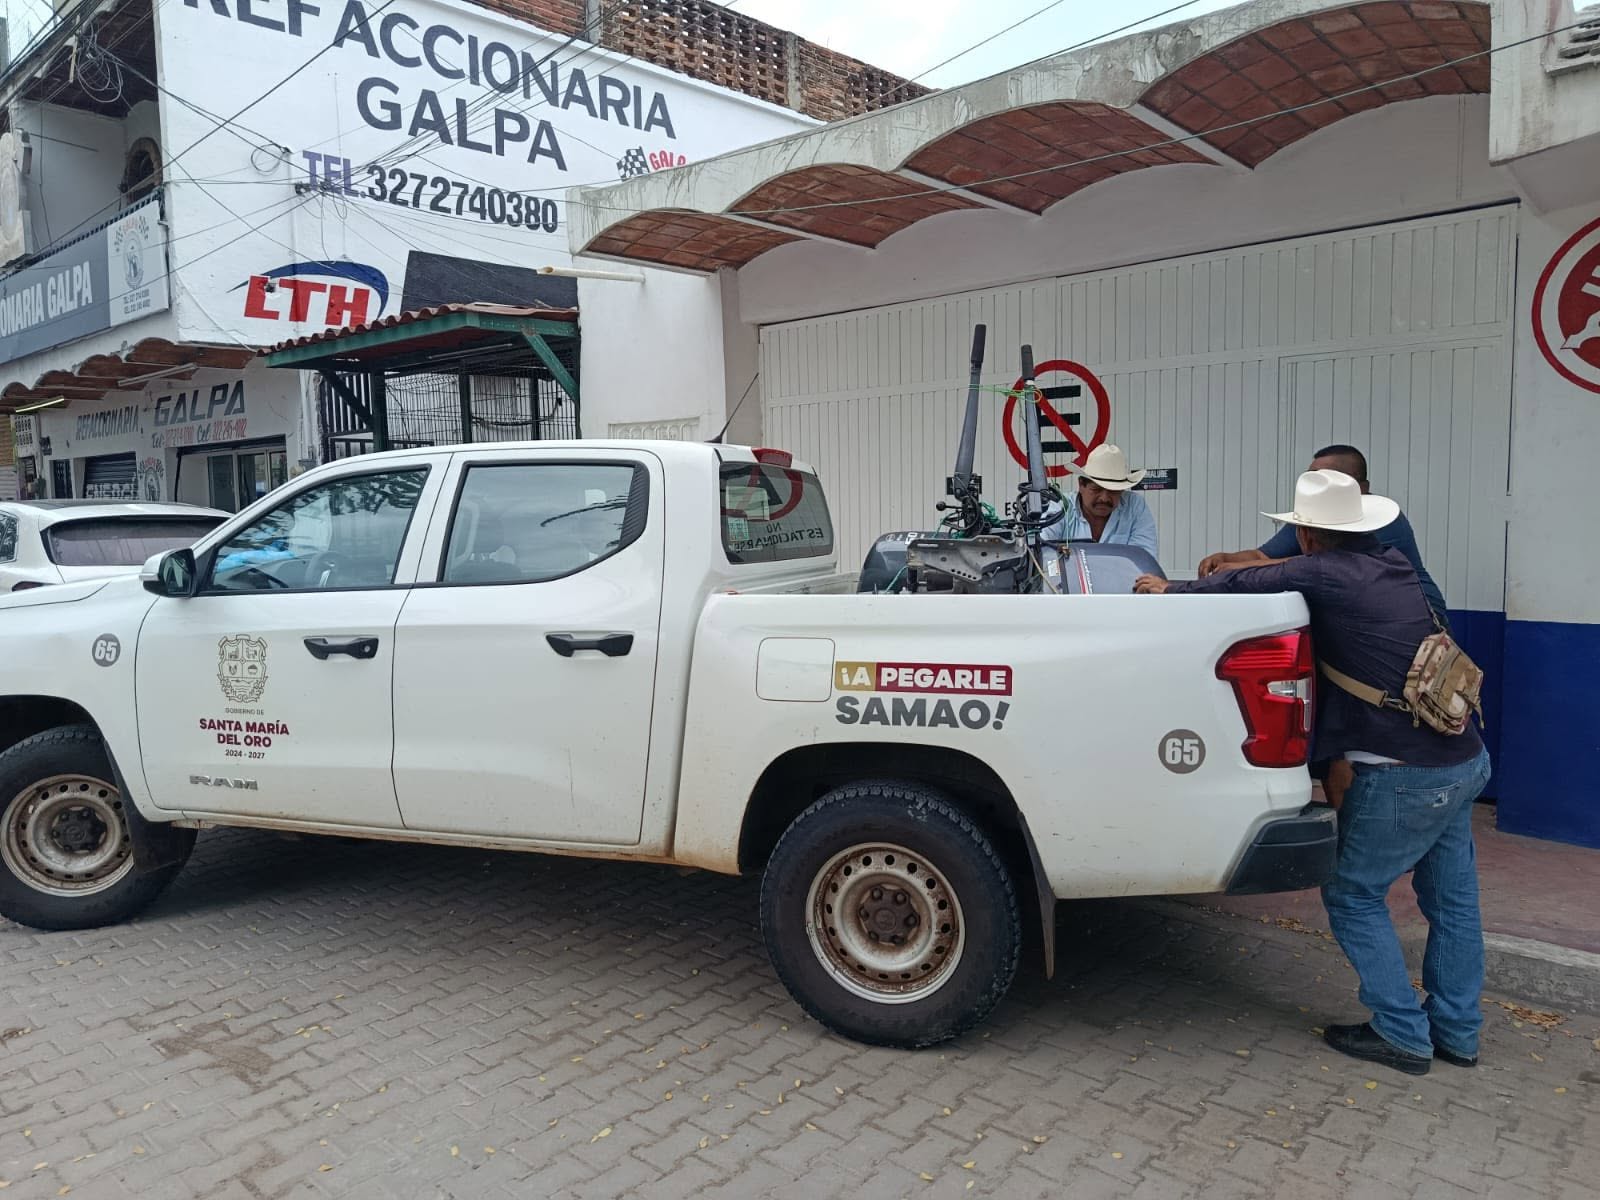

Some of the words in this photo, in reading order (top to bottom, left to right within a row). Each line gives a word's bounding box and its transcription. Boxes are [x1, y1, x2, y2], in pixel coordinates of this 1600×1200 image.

[184, 0, 676, 140] FACCIONARIA
[356, 77, 568, 171] GALPA
[367, 164, 558, 233] 3272740380
[47, 261, 93, 319] GALPA
[244, 275, 371, 328] LTH
[154, 380, 246, 427] GALPA
[76, 404, 139, 440] REFACCIONARIA
[95, 639, 117, 662] 65
[880, 667, 1007, 691] PEGARLE
[199, 718, 243, 732] SANTA
[245, 720, 290, 735] MARÍA
[225, 707, 255, 715] GOBIERNO
[835, 696, 1010, 731] SAMAO!
[217, 733, 241, 746] DEL
[244, 735, 272, 748] ORO
[225, 749, 242, 758] 2024
[248, 751, 265, 759] 2027
[1164, 738, 1200, 766] 65
[189, 775, 258, 791] RAM
